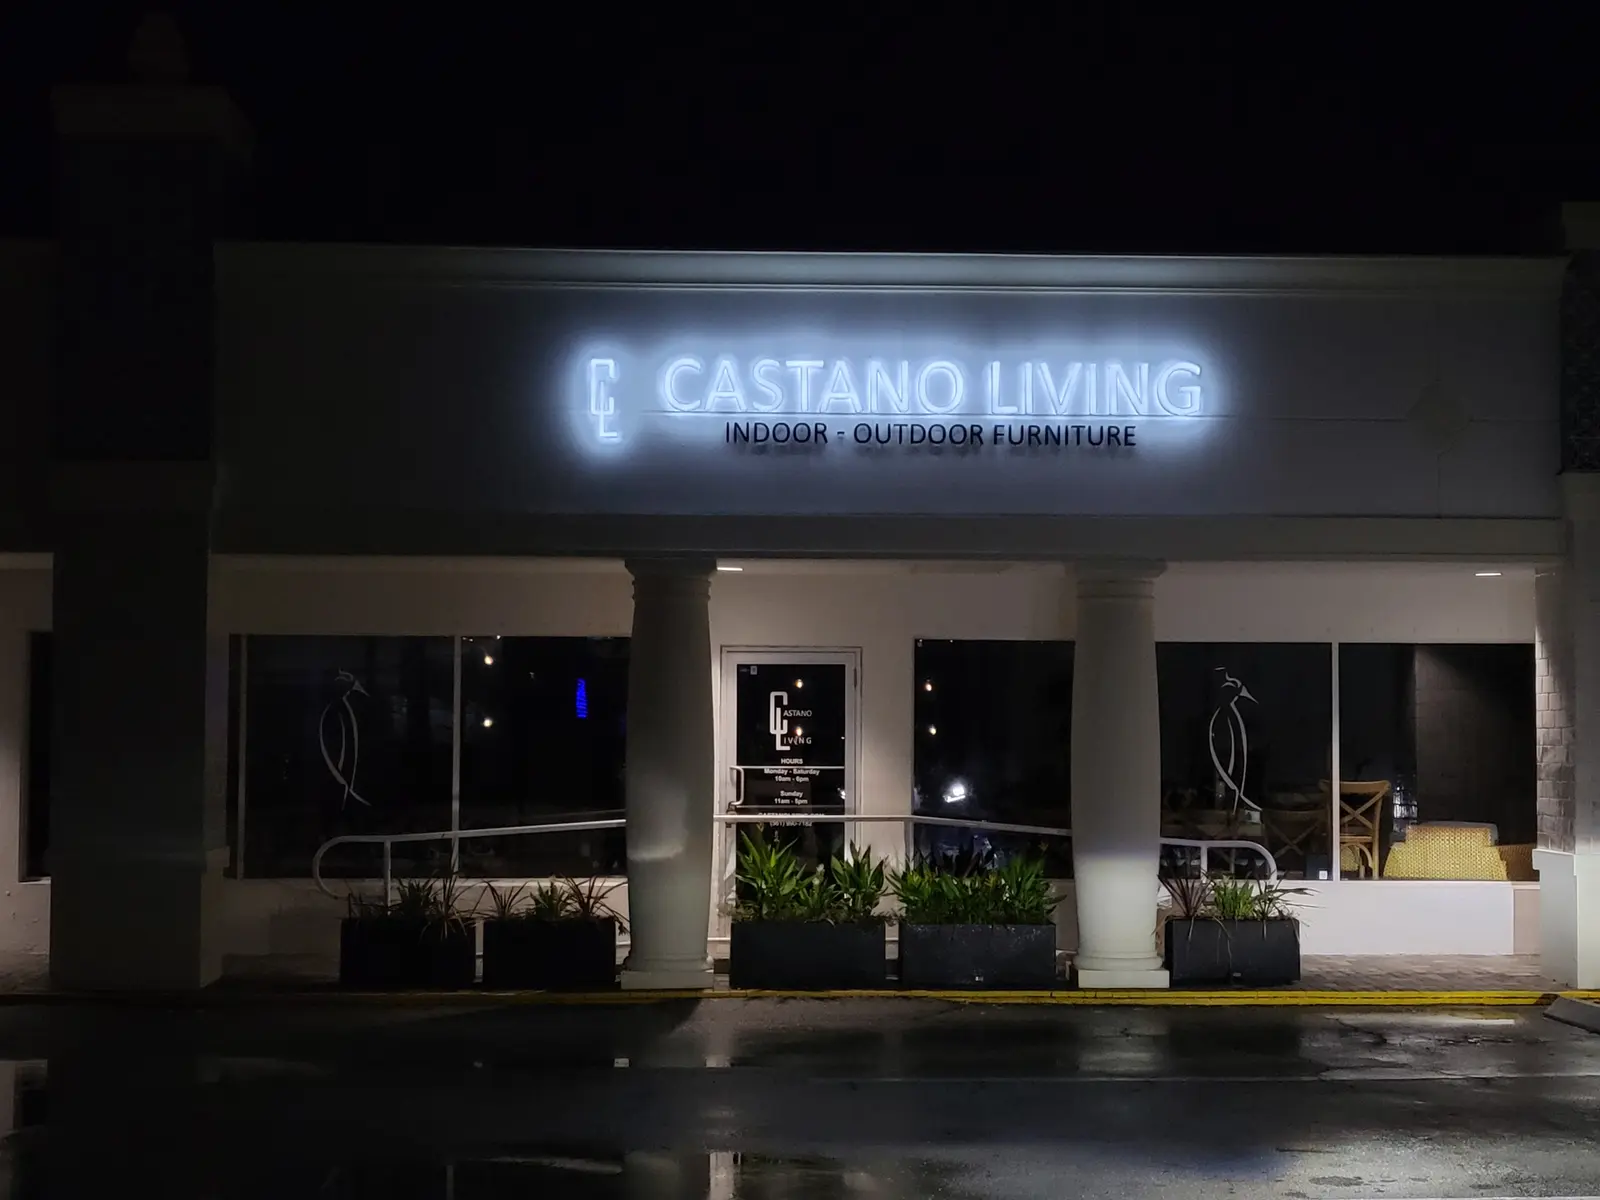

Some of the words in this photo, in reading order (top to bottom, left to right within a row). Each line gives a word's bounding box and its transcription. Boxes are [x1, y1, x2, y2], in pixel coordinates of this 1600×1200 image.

[663, 357, 965, 414] CASTANO
[988, 361, 1202, 415] LIVING
[725, 421, 829, 445] INDOOR
[853, 422, 984, 445] OUTDOOR
[993, 424, 1137, 447] FURNITURE
[764, 768, 788, 776] Monday
[793, 768, 820, 776] Saturday
[780, 790, 803, 798] Sunday
